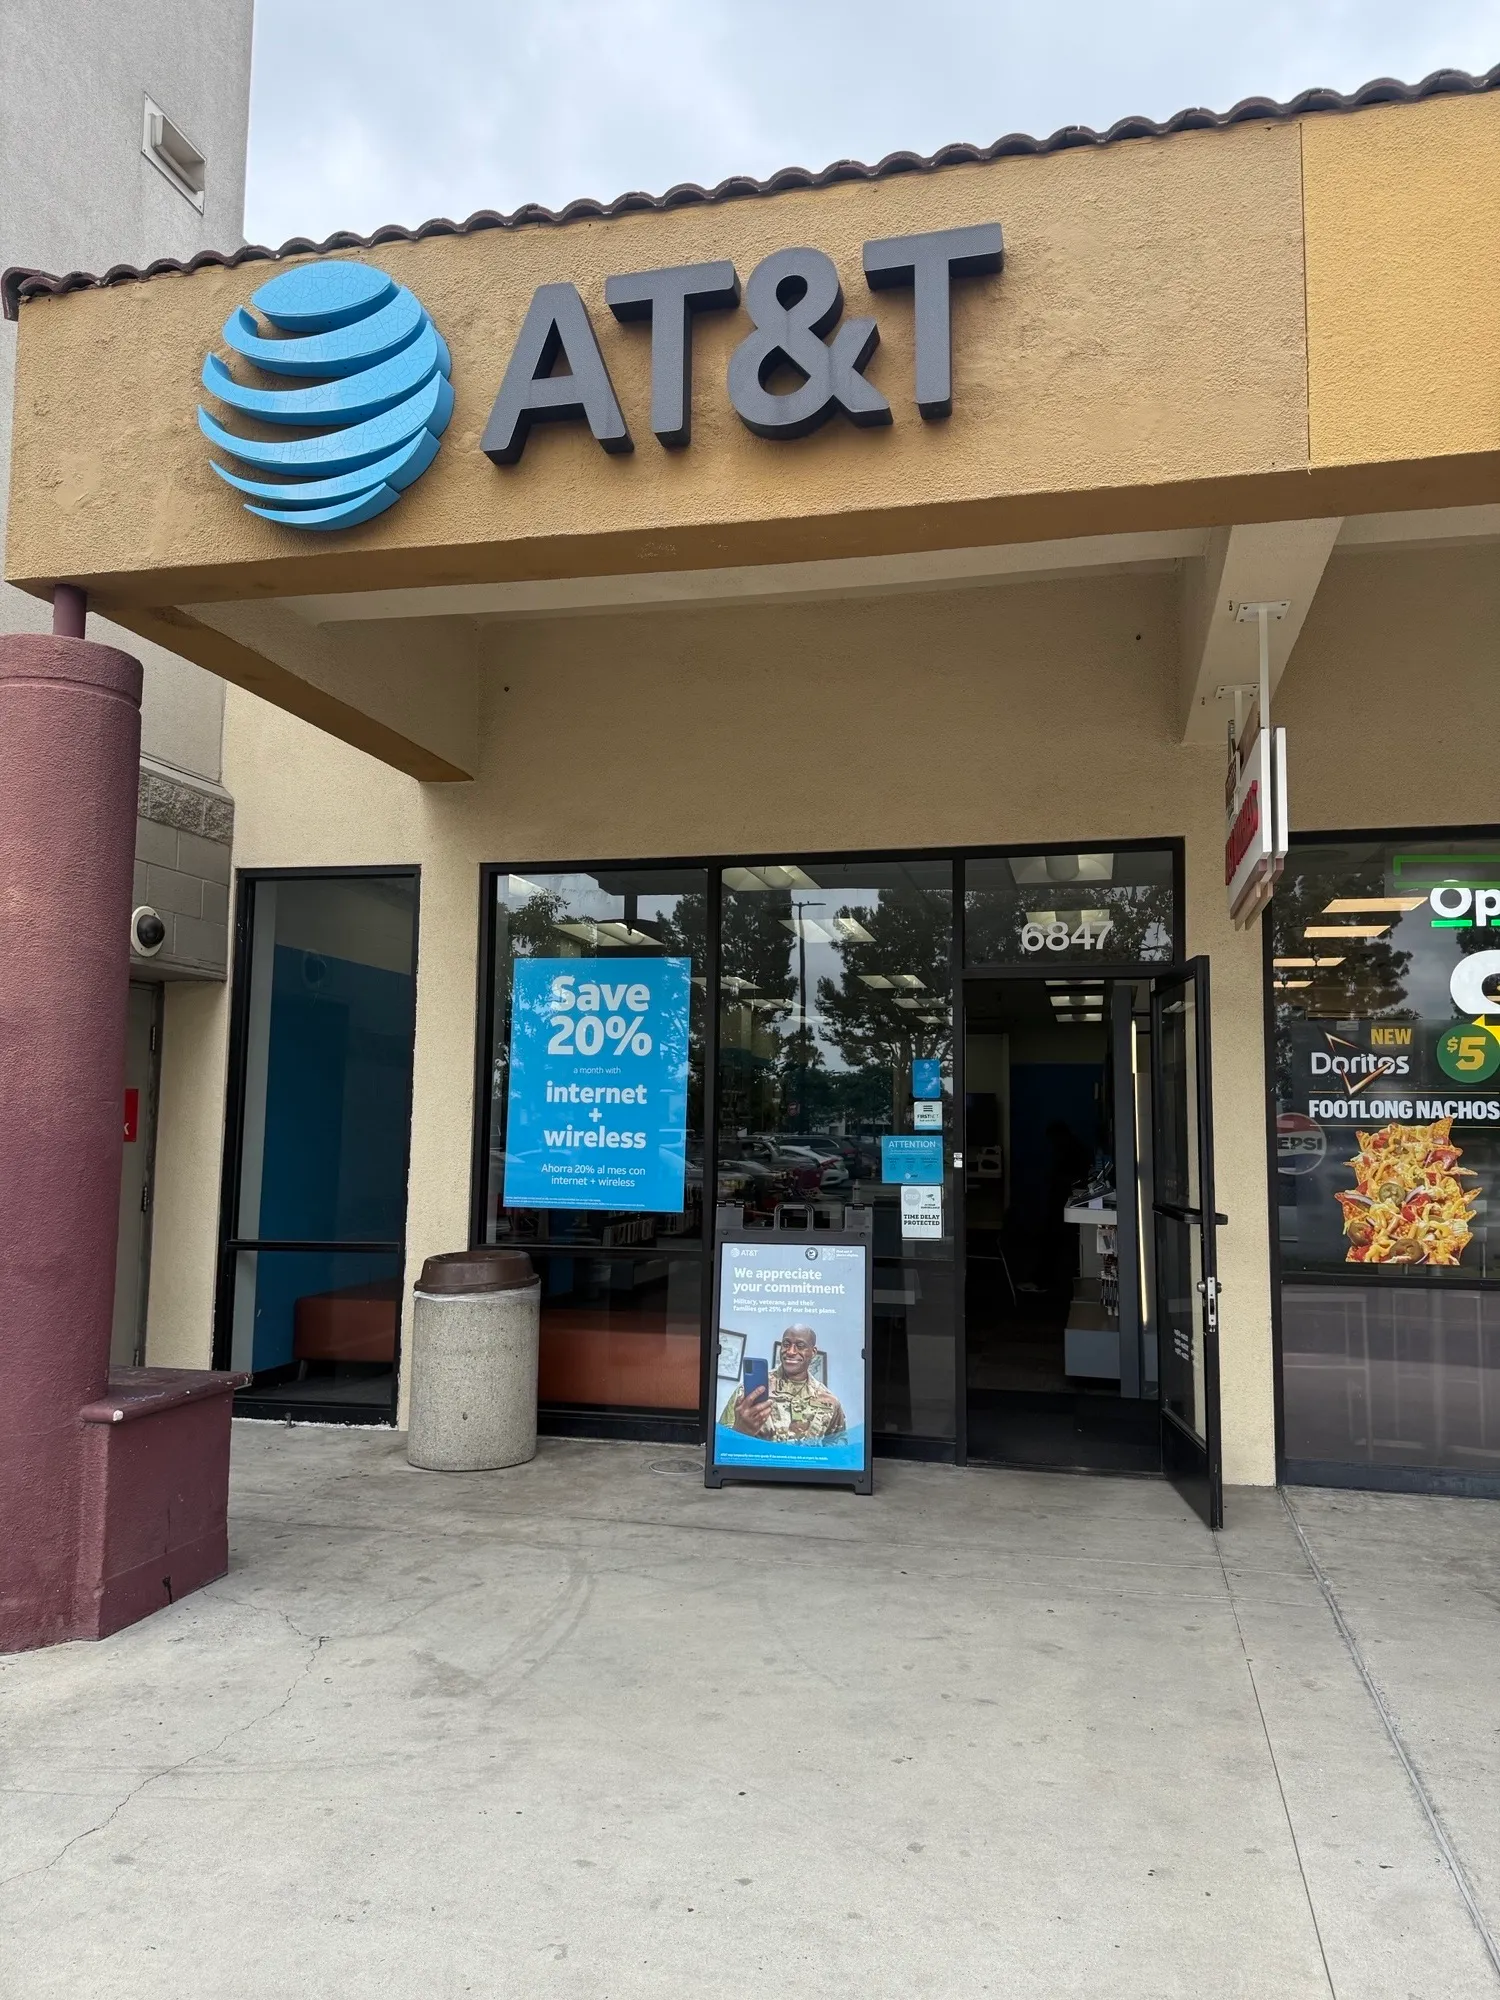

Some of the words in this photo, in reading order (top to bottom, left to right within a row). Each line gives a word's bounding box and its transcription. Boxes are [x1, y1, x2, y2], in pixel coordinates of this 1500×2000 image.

[479, 222, 1004, 465] AT&T
[1021, 920, 1114, 951] 6847
[550, 975, 650, 1012] Save
[547, 1015, 653, 1056] 20%
[1370, 1028, 1412, 1045] NEW
[1446, 1036, 1487, 1071] $5
[579, 1066, 604, 1074] month
[605, 1066, 621, 1074] with
[1311, 1051, 1410, 1075] Doritos
[546, 1080, 648, 1104] internet
[588, 1107, 603, 1123] +
[1308, 1100, 1413, 1119] FOOTLONG
[1416, 1100, 1500, 1120] NACHOS
[543, 1125, 647, 1149] wireless
[888, 1140, 936, 1148] ATTENTION
[1277, 1137, 1323, 1150] EPSI
[541, 1163, 573, 1174] Ahorra
[574, 1164, 595, 1174] 20%
[597, 1165, 605, 1174] al
[607, 1167, 627, 1175] mes
[628, 1167, 646, 1176] con
[551, 1176, 588, 1186] internet
[598, 1177, 636, 1187] wireless
[741, 1249, 758, 1257] AT&T
[734, 1267, 753, 1278] We
[756, 1268, 822, 1281] appreciate
[732, 1283, 762, 1294] your
[765, 1282, 845, 1294] commitment
[733, 1298, 758, 1306] Military,
